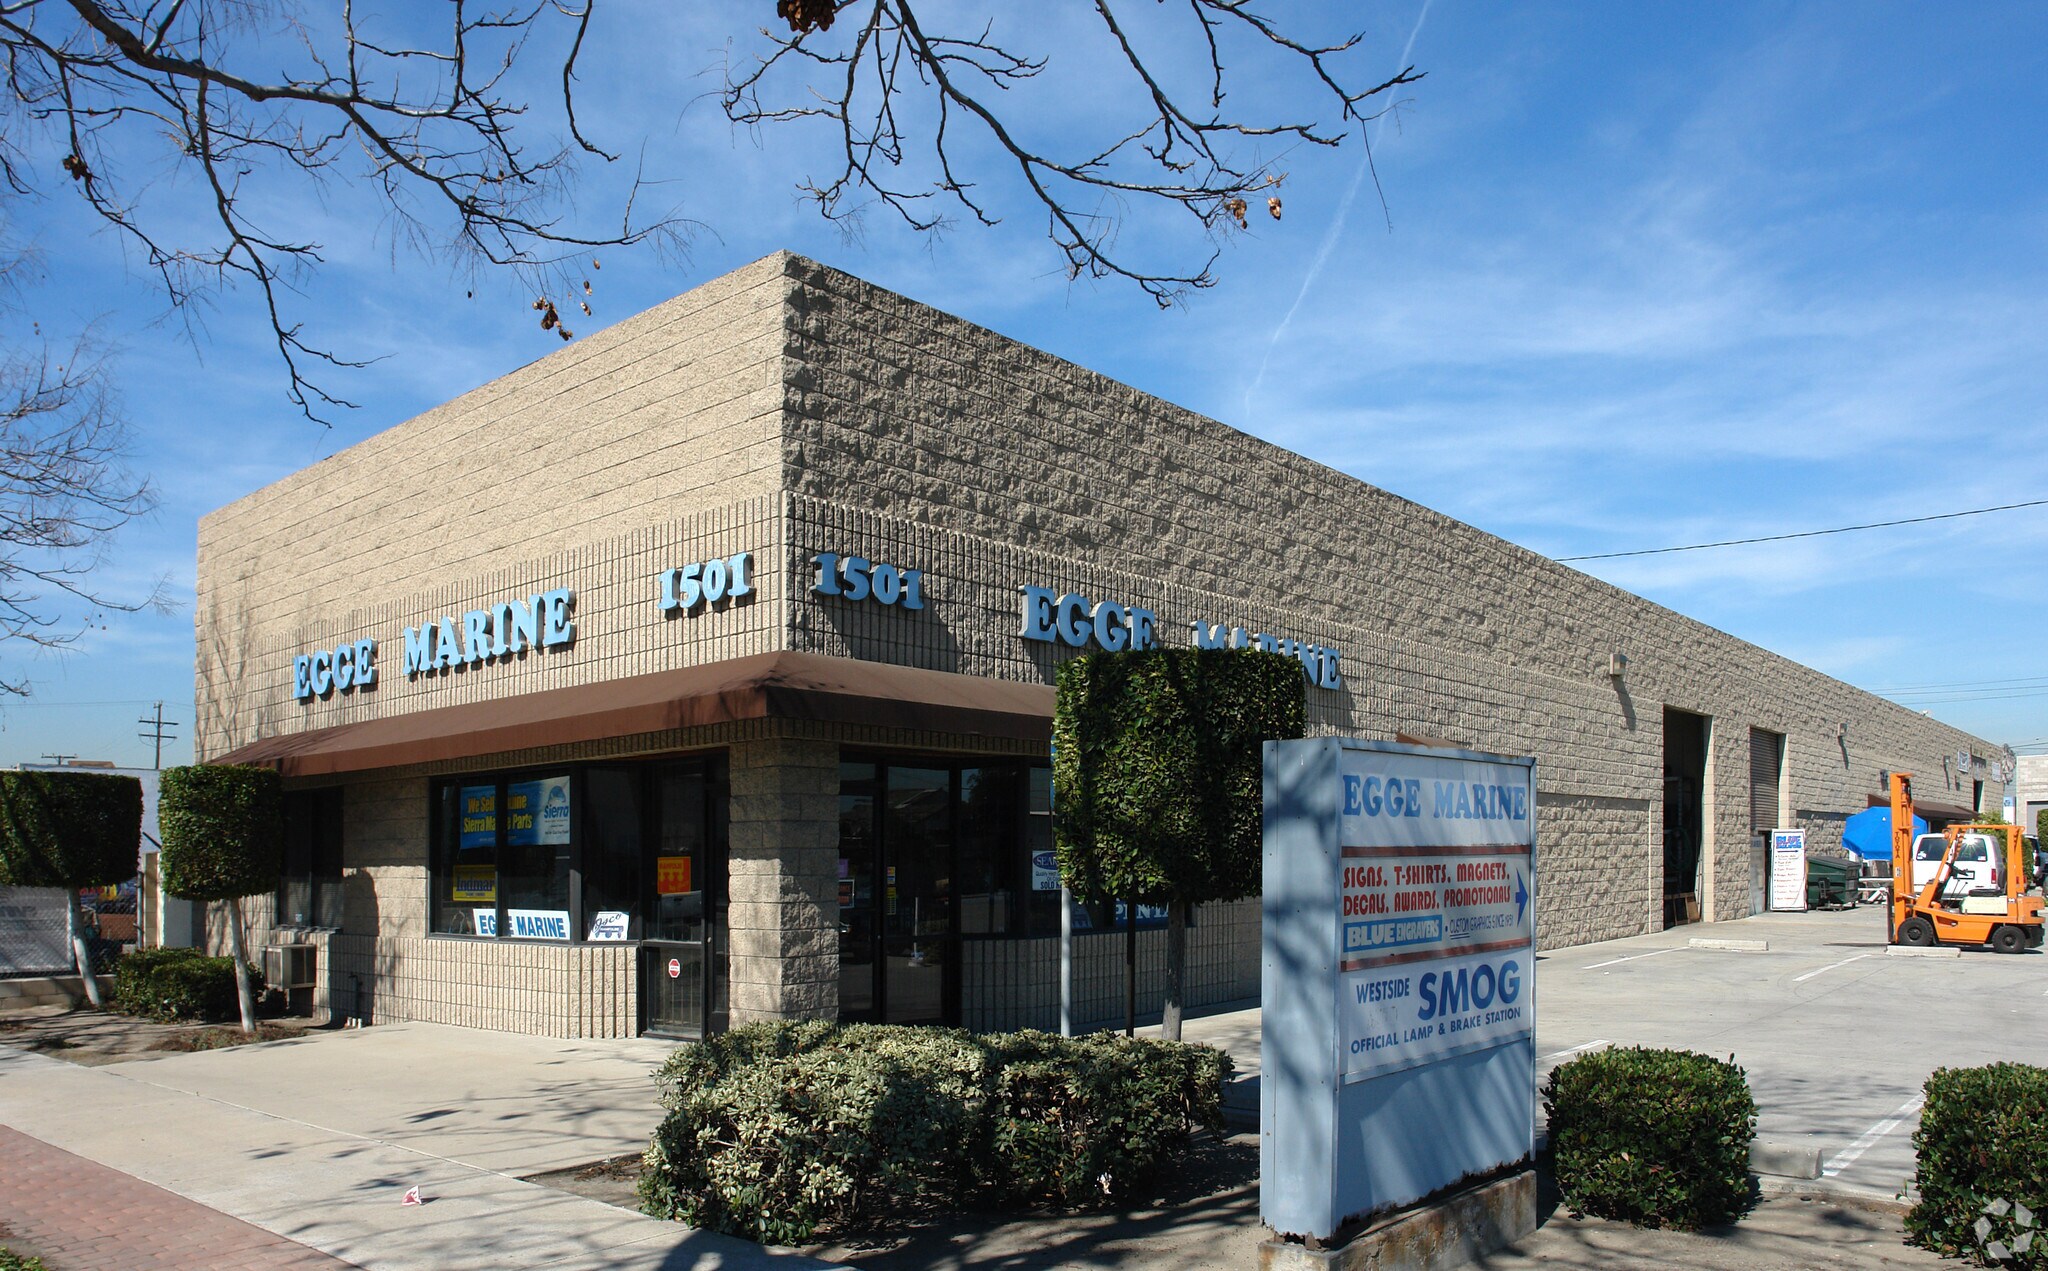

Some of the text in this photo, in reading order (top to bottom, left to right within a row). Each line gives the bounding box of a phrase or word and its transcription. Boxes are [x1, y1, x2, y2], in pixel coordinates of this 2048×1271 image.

[657, 552, 753, 611] 1501
[810, 553, 924, 610] 1501
[1020, 585, 1157, 652] EGGE
[293, 587, 573, 700] EGGE MARINE
[468, 798, 479, 813] We
[1343, 774, 1526, 820] EGGE MARINE
[463, 817, 484, 833] Sierra
[512, 813, 532, 830] Parts
[1443, 885, 1511, 908] PROMOTIONALS
[479, 914, 567, 938] EGE MARINE
[1346, 919, 1440, 948] BLUE ENGRAVERS
[1356, 960, 1521, 1020] WESTSIDE SMOG
[1351, 1007, 1521, 1054] OFFICIAL LAMP & BRAKE STATION
